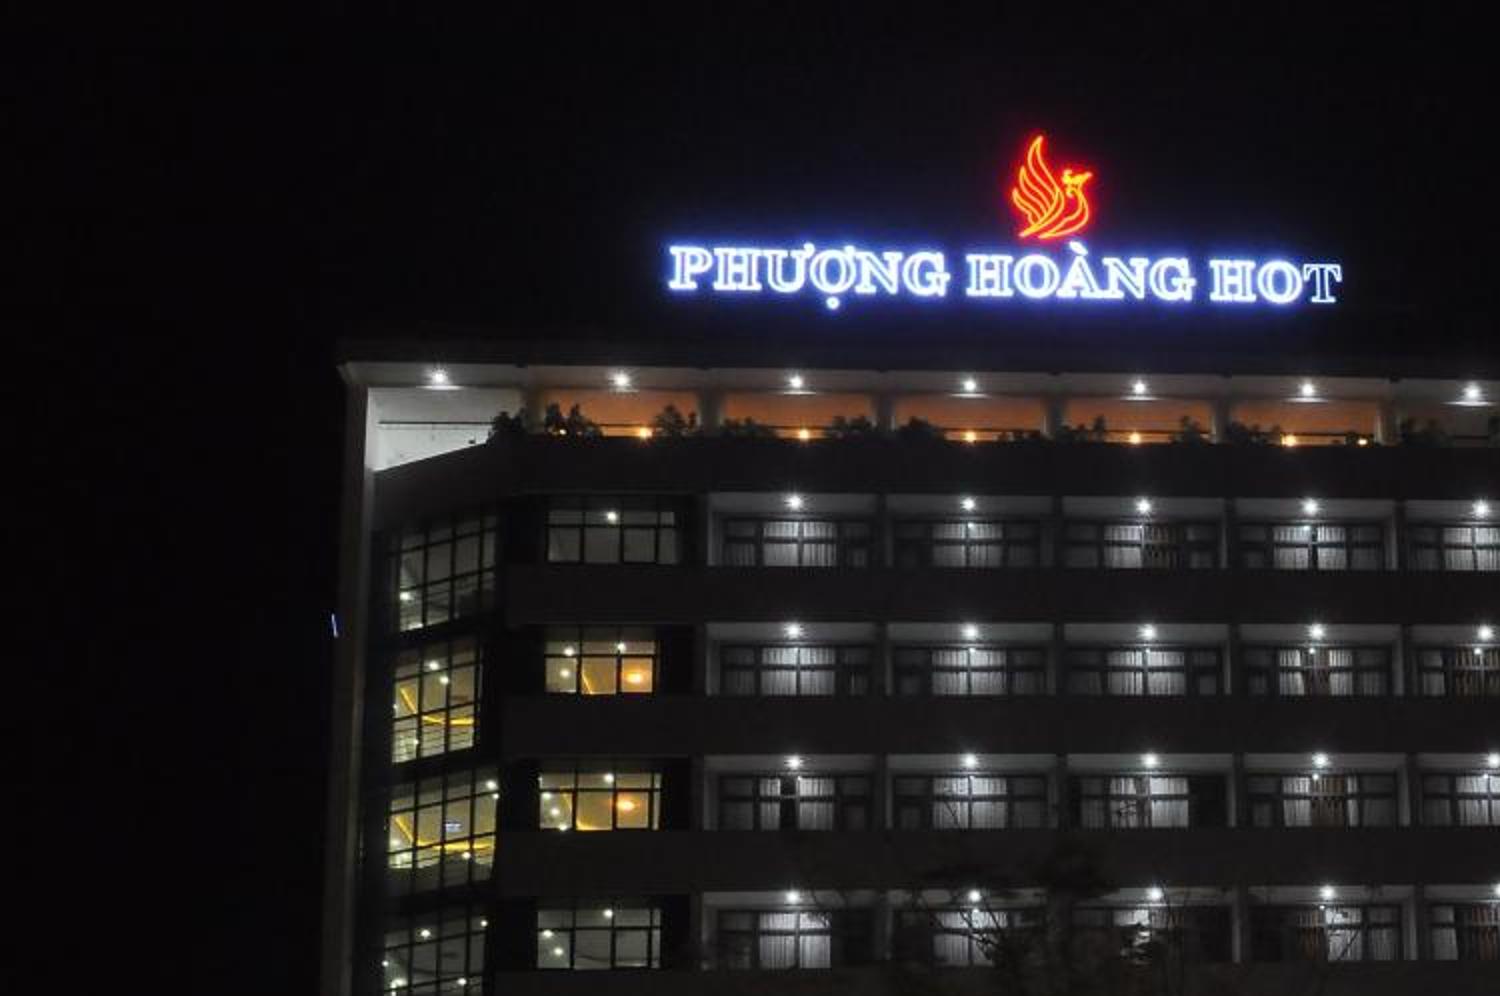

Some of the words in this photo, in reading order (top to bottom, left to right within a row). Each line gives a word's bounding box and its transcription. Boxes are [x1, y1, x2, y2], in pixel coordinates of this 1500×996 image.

[668, 242, 951, 309] PHƯỢNG
[965, 241, 1196, 301] HOÀNG
[1209, 259, 1343, 304] HOT
